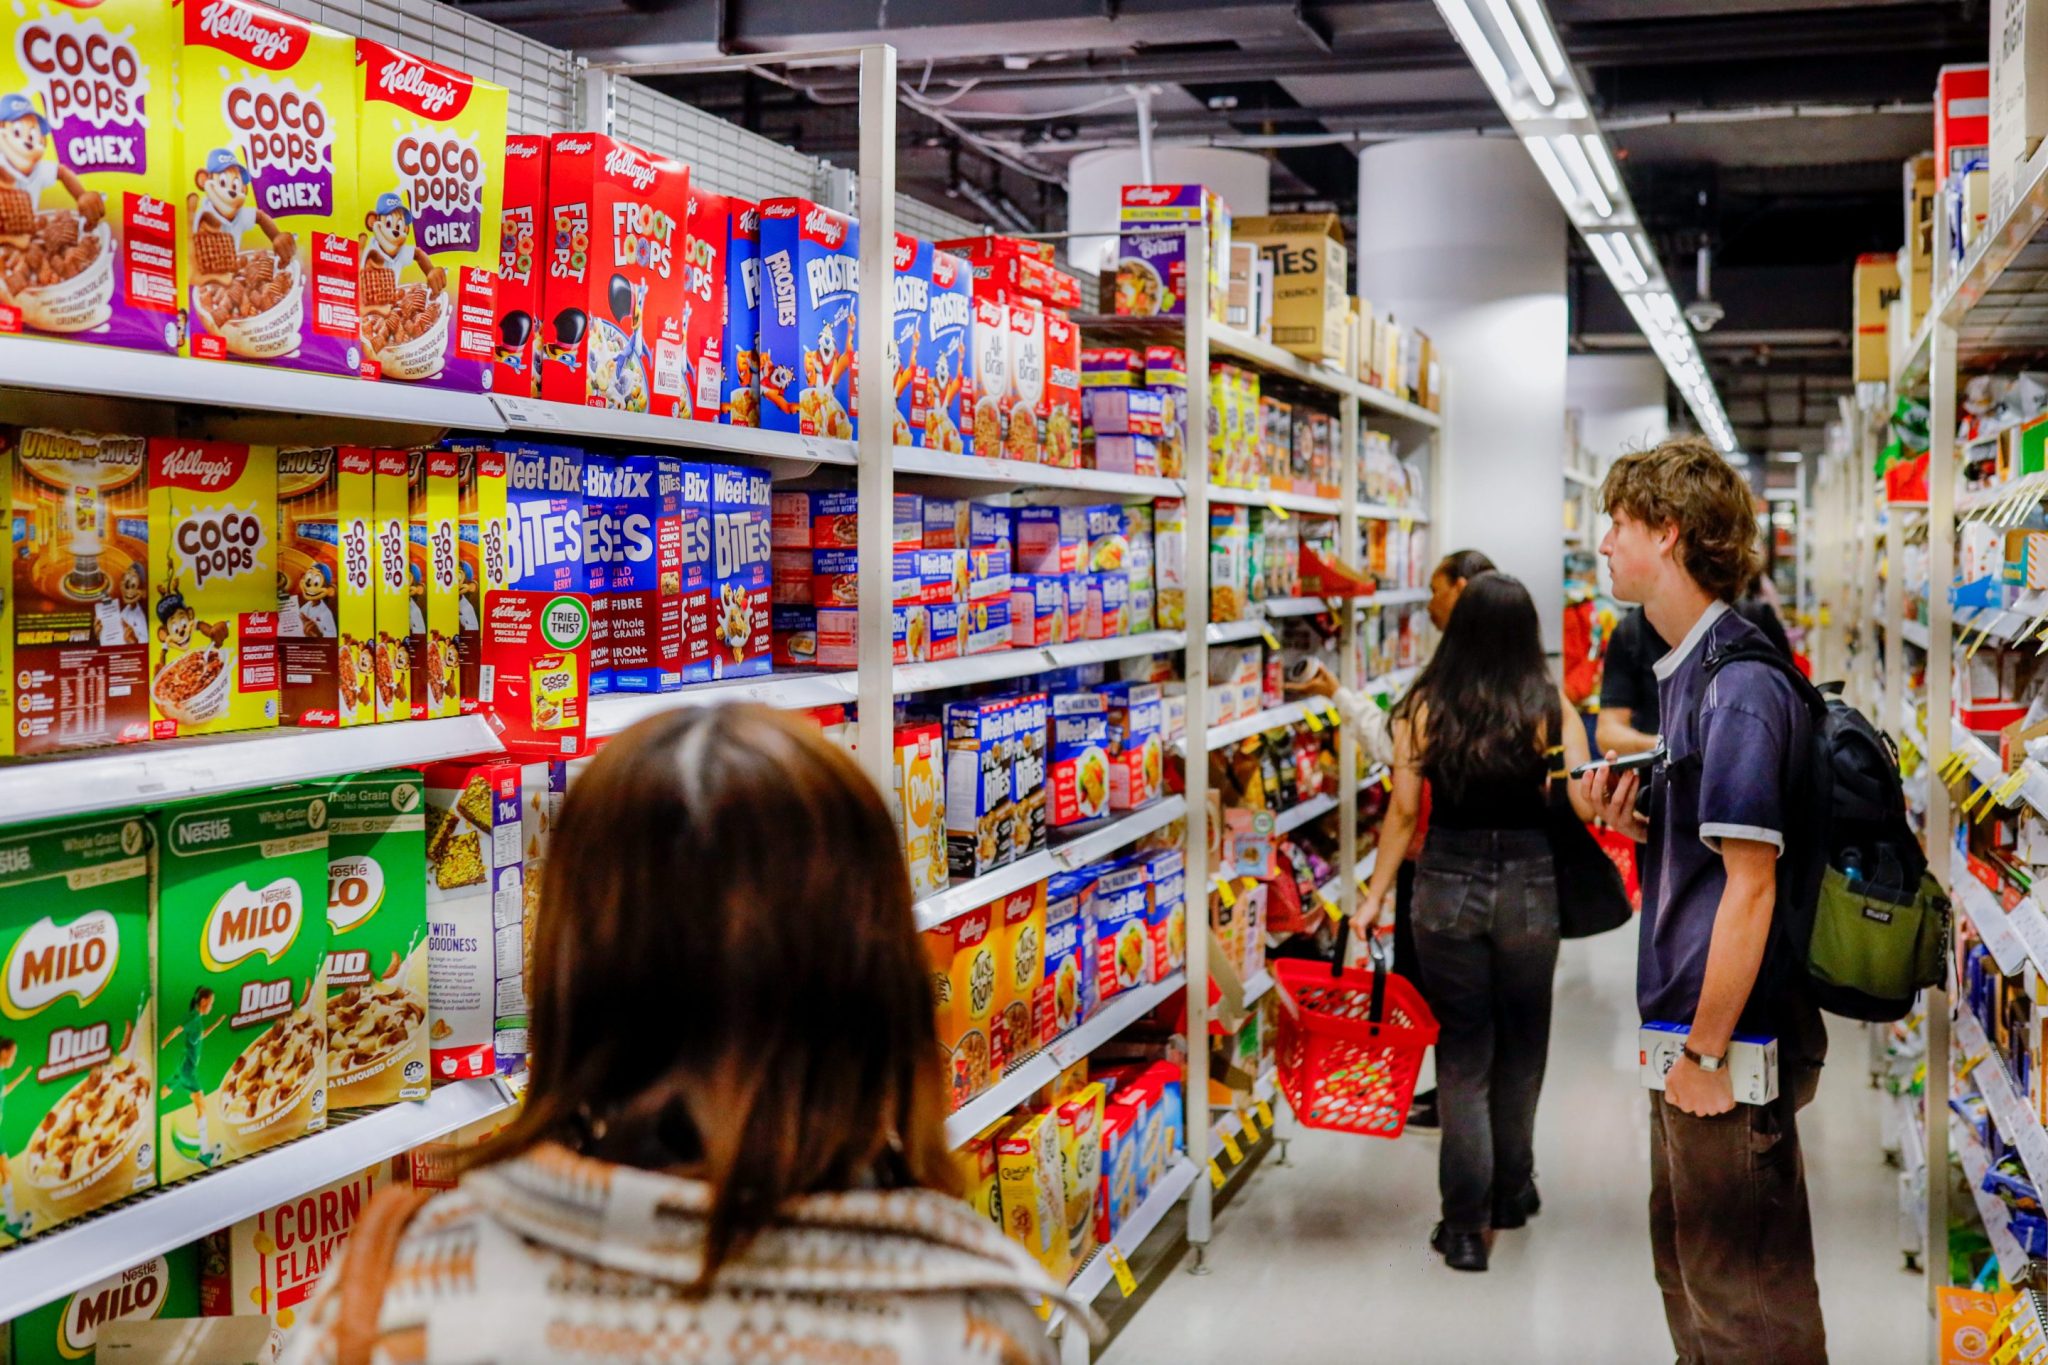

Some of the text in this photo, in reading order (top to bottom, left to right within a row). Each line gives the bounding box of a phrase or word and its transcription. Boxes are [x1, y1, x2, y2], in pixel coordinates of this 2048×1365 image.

[200, 1, 293, 61] Kellogg's
[23, 26, 137, 87] COCO
[50, 78, 128, 119] pops
[379, 59, 458, 113] Kellogg's
[228, 87, 325, 138] COCO
[68, 135, 136, 166] CHEX
[249, 133, 317, 170] pops
[397, 137, 479, 182] COCO
[556, 139, 593, 155] Kellogg's
[605, 147, 657, 190] Kellogg's
[265, 183, 323, 210] CHEX
[414, 177, 471, 212] pops
[424, 221, 471, 247] CHEX
[612, 201, 676, 248] FROOT
[805, 209, 843, 244] Kellogg's
[499, 208, 518, 281] LOOPS
[513, 205, 534, 287] FROOT
[551, 205, 571, 279] LOOPS
[567, 202, 589, 284] FROOT
[685, 233, 717, 273] OOT
[613, 233, 673, 280] LOOPS
[1262, 243, 1318, 276] TES
[764, 249, 797, 328] FROSTIES
[893, 275, 929, 312] OSTIES
[318, 302, 333, 325] NO
[930, 292, 970, 342] FROSTIES
[461, 330, 473, 349] NO
[985, 353, 1005, 376] Bran
[1019, 361, 1040, 382] Bran
[161, 447, 233, 486] Kellogg's
[658, 461, 680, 473] Weet-Bix
[714, 471, 770, 506] Weet-Bix
[178, 513, 260, 555] COCO
[507, 499, 582, 584] BITES
[660, 534, 680, 543] CRUNCH
[714, 511, 771, 579] BITES
[343, 535, 356, 582] pops
[353, 520, 368, 589] COCO
[380, 535, 392, 581] pops
[389, 521, 403, 588] COCO
[431, 535, 444, 581] pops
[441, 521, 453, 586] COCO
[483, 534, 494, 579] pops
[491, 521, 503, 584] COCO
[663, 550, 676, 559] FILLS
[196, 546, 253, 586] pops
[554, 567, 570, 579] WILD
[553, 578, 572, 591] BERRY
[589, 578, 605, 589] BERRY
[592, 599, 608, 612] FIBRE
[612, 598, 642, 611] FIBRE
[690, 595, 706, 608] FIBRE
[754, 592, 768, 605] FIBRE
[491, 605, 532, 621] Kellogg's
[551, 612, 580, 622] TRIED
[592, 619, 608, 630] Whole
[612, 618, 645, 630] Whole
[690, 613, 707, 624] Whole
[755, 610, 768, 621] Whole
[755, 619, 768, 629] GRAINS
[551, 622, 580, 634] THIS?
[592, 629, 608, 640] GRAINS
[613, 628, 646, 639] GRAINS
[691, 623, 707, 634] GRAINS
[755, 635, 769, 646] IRON+
[591, 647, 608, 659] IRON+
[613, 646, 647, 658] IRON+
[690, 639, 708, 651] IRON+
[535, 659, 560, 668] Kellogg's
[619, 656, 648, 665] Vitamins
[242, 667, 255, 684] NO
[541, 673, 570, 686] COCO
[548, 681, 568, 692] pops
[359, 791, 389, 801] Grain
[258, 808, 307, 824] Whole Grain
[179, 818, 231, 845] Nestlé
[261, 886, 292, 904] Nestlé
[219, 902, 292, 947] MILO
[432, 923, 456, 936] WITH
[428, 937, 478, 952] GOODNESS
[21, 938, 106, 991] MILO
[336, 1063, 385, 1086] FLAVOURED
[274, 1180, 362, 1252] CORN
[122, 1258, 158, 1284] Nestlé
[76, 1274, 159, 1335] MILO
